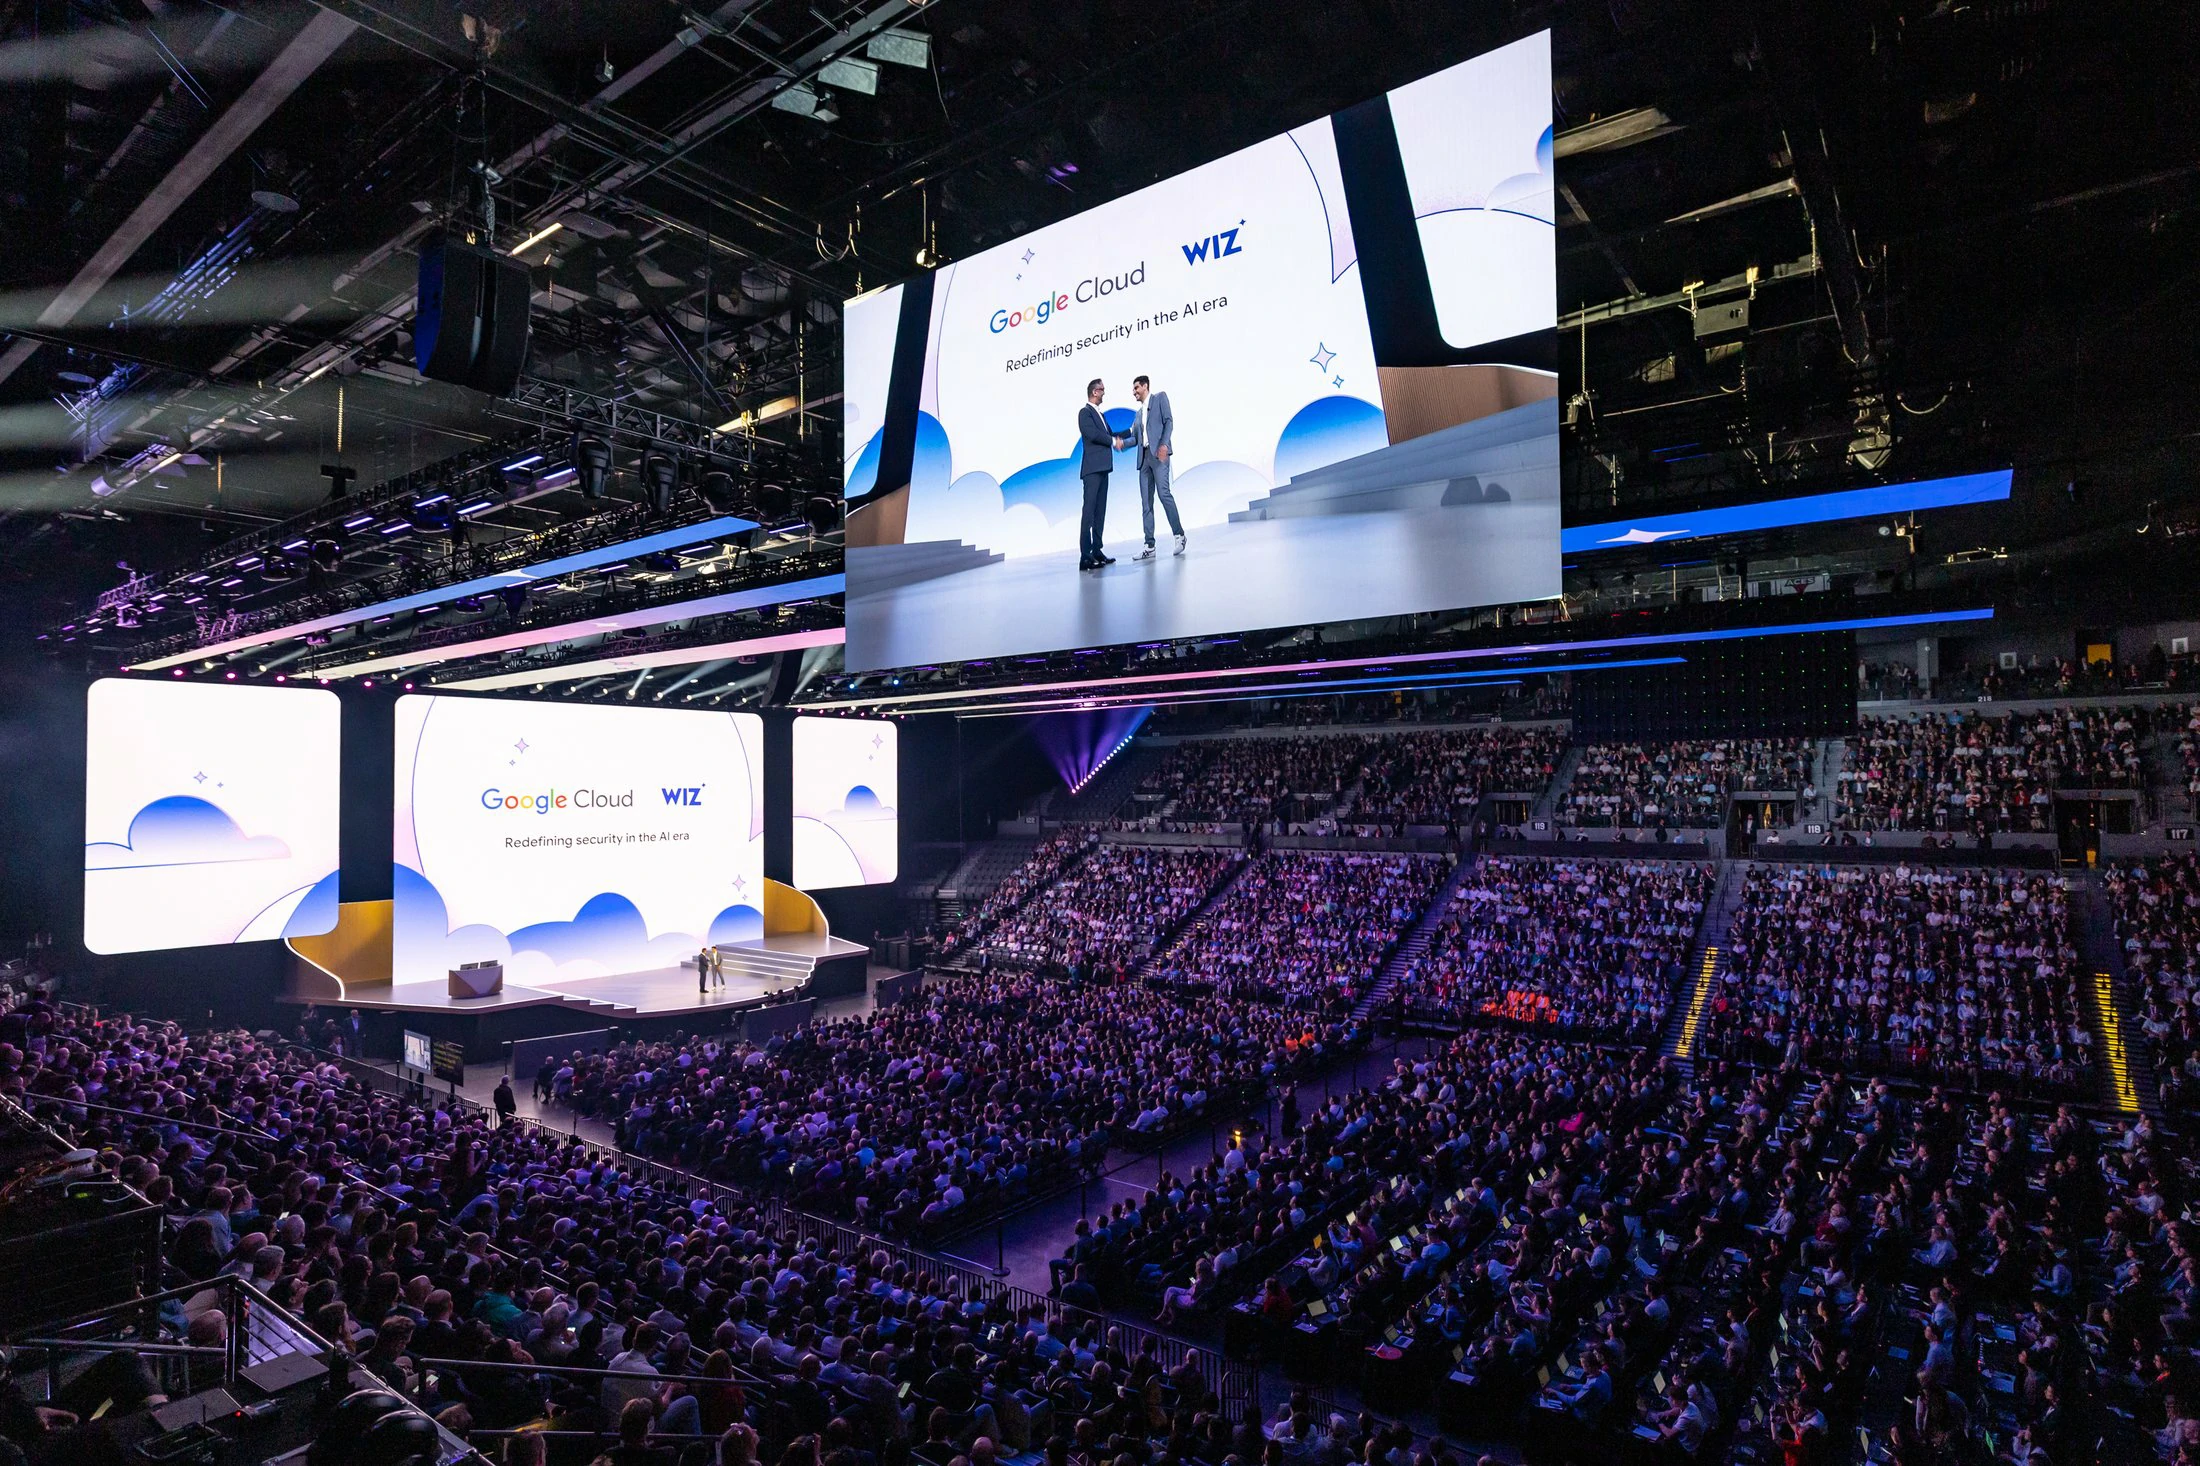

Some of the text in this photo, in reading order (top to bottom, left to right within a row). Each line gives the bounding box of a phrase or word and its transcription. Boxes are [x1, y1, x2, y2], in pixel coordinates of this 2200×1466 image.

[1181, 228, 1242, 266] WIZ
[990, 261, 1145, 334] Google Cloud
[1005, 297, 1228, 373] Redefining security in the AI era
[481, 788, 633, 814] Google Cloud
[661, 788, 702, 806] WIZ
[1534, 822, 1546, 830] 119
[1807, 824, 1821, 834] 118
[2171, 829, 2188, 839] 117
[505, 831, 690, 849] Redefining security in the AI era
